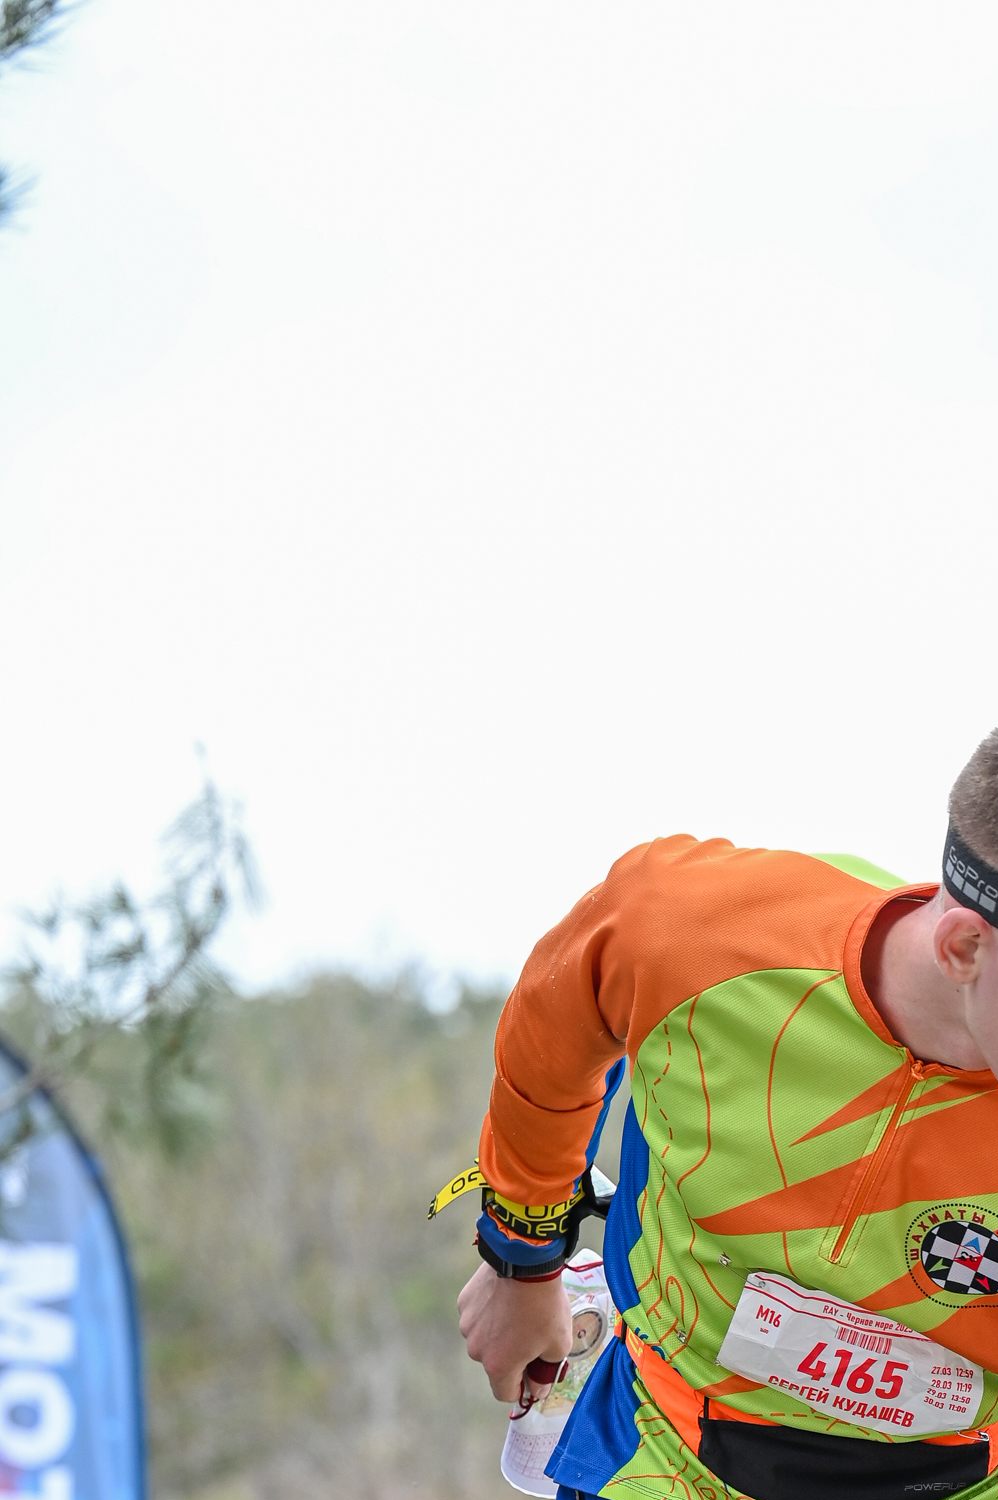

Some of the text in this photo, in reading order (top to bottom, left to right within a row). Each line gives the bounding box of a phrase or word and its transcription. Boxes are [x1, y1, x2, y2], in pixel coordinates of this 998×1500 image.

[949, 846, 998, 899] GoPro
[909, 1209, 986, 1261] ШАХМАТЫ
[822, 1305, 839, 1317] RAY
[846, 1312, 874, 1327] Черное
[874, 1320, 894, 1331] море
[797, 1342, 909, 1399] 4165
[931, 1366, 974, 1379] 27.03 12:59
[927, 1387, 971, 1404] 29.03 13:50
[931, 1379, 973, 1393] 28.03 11:19
[767, 1375, 915, 1428] СЕРГЕЙ КУДАШЕВ
[923, 1396, 967, 1413] 30.03 11:00
[904, 1481, 966, 1491] POWERUP
